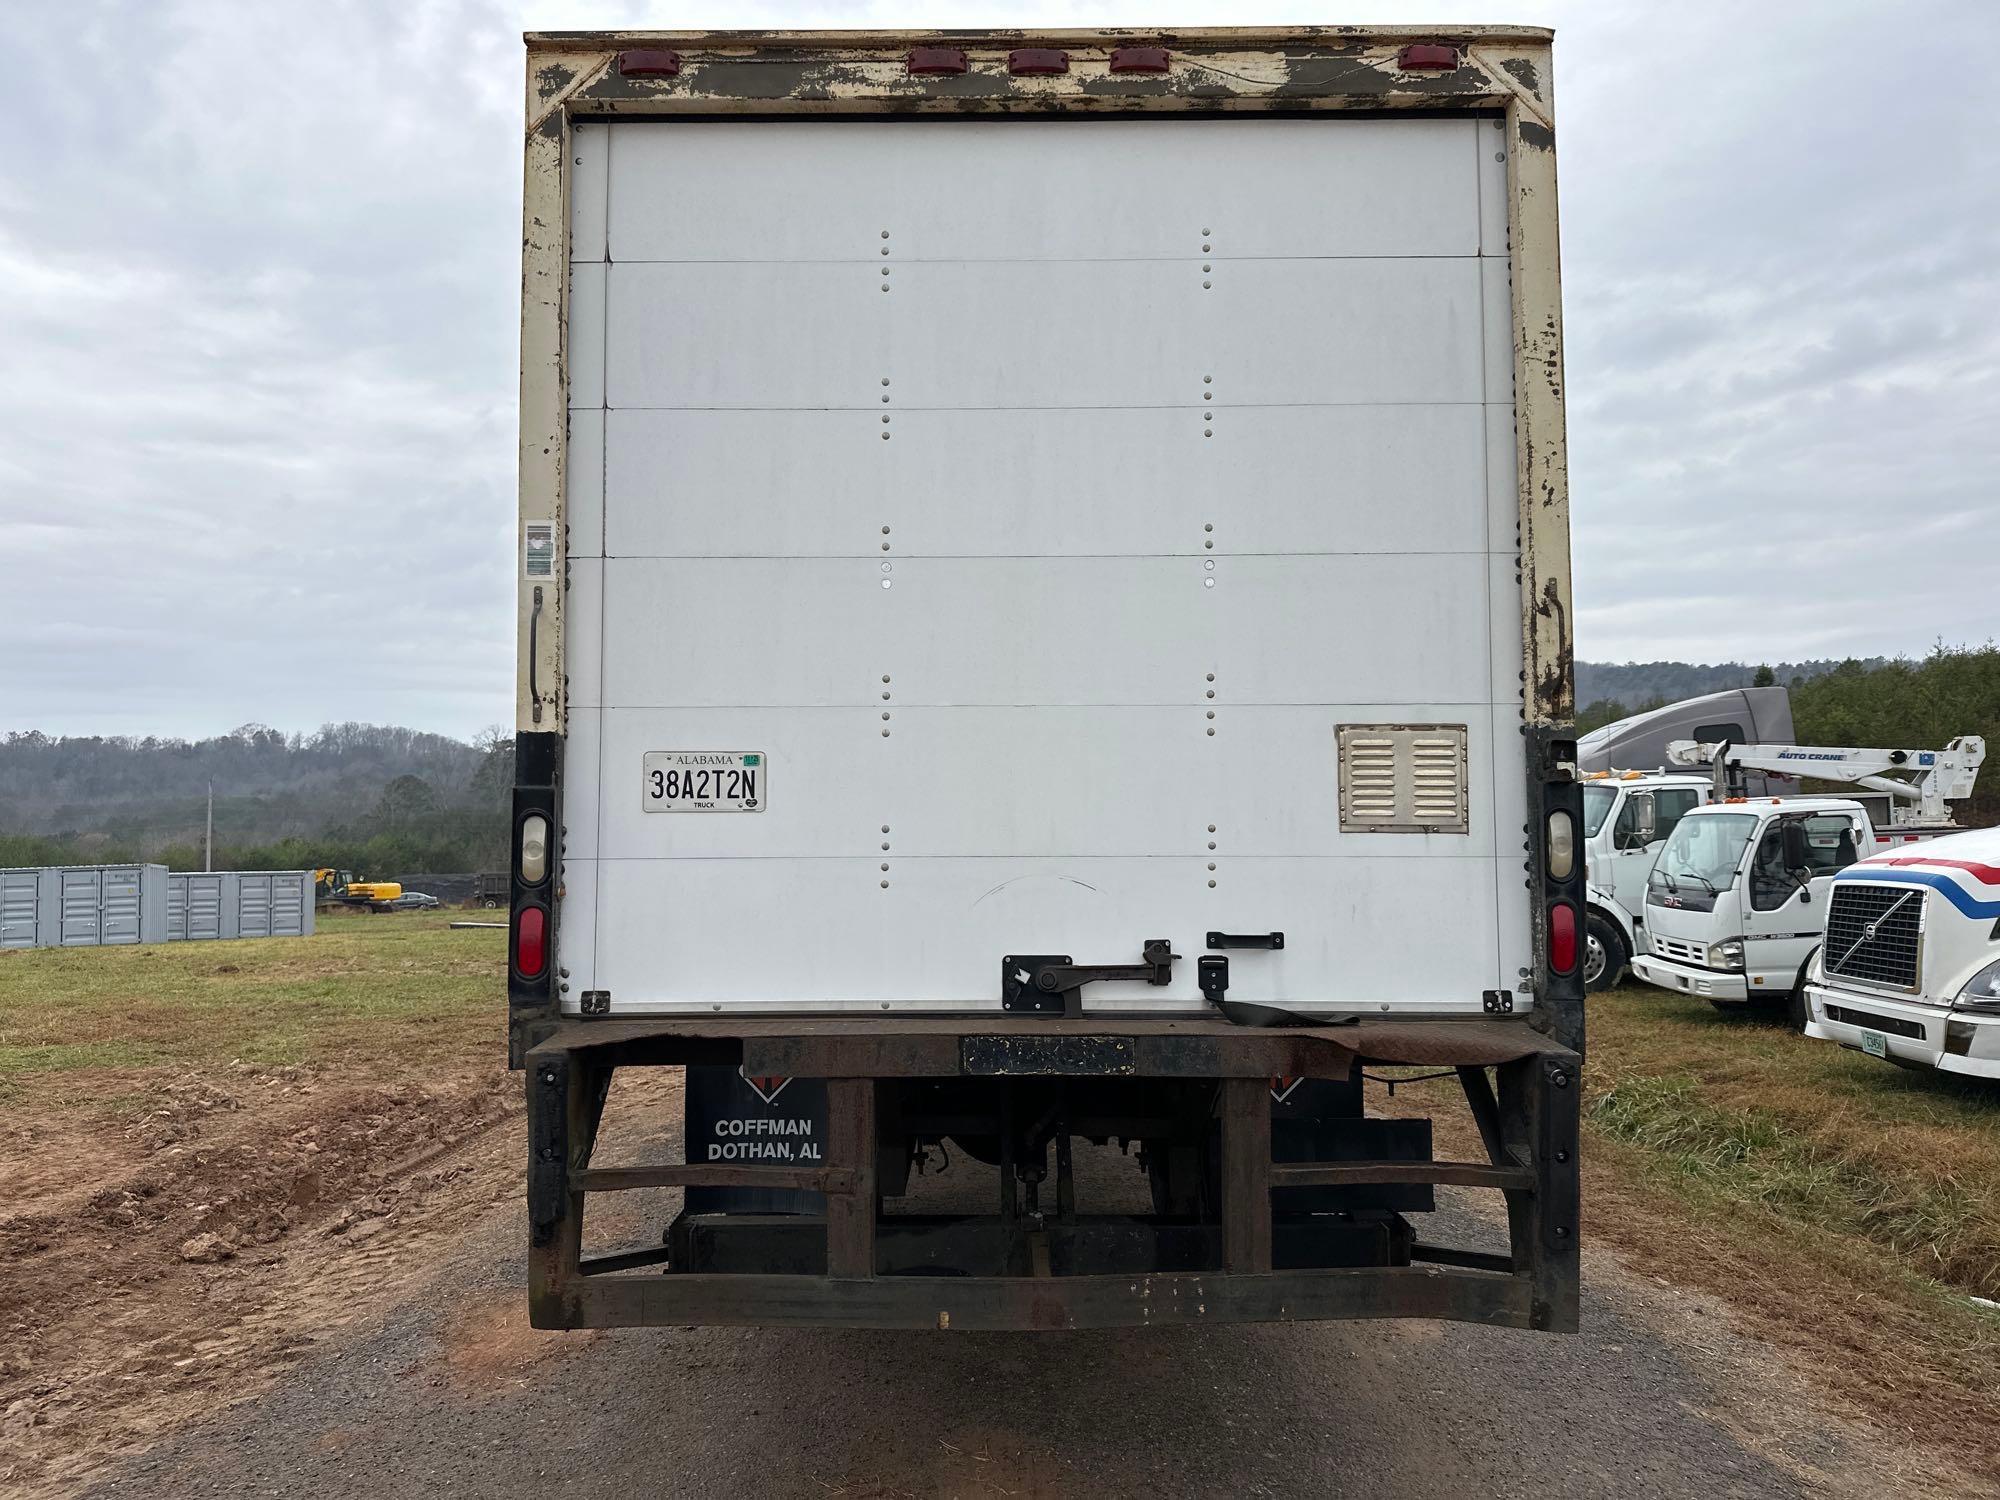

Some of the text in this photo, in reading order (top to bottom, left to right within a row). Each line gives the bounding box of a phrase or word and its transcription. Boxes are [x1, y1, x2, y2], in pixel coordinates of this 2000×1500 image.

[676, 756, 733, 765] ALABAMA
[1777, 752, 1807, 760] AUTO
[651, 770, 755, 799] 38A2T2N
[715, 1119, 811, 1136] COFFMAN
[708, 1142, 822, 1162] DOTHAN, AL
